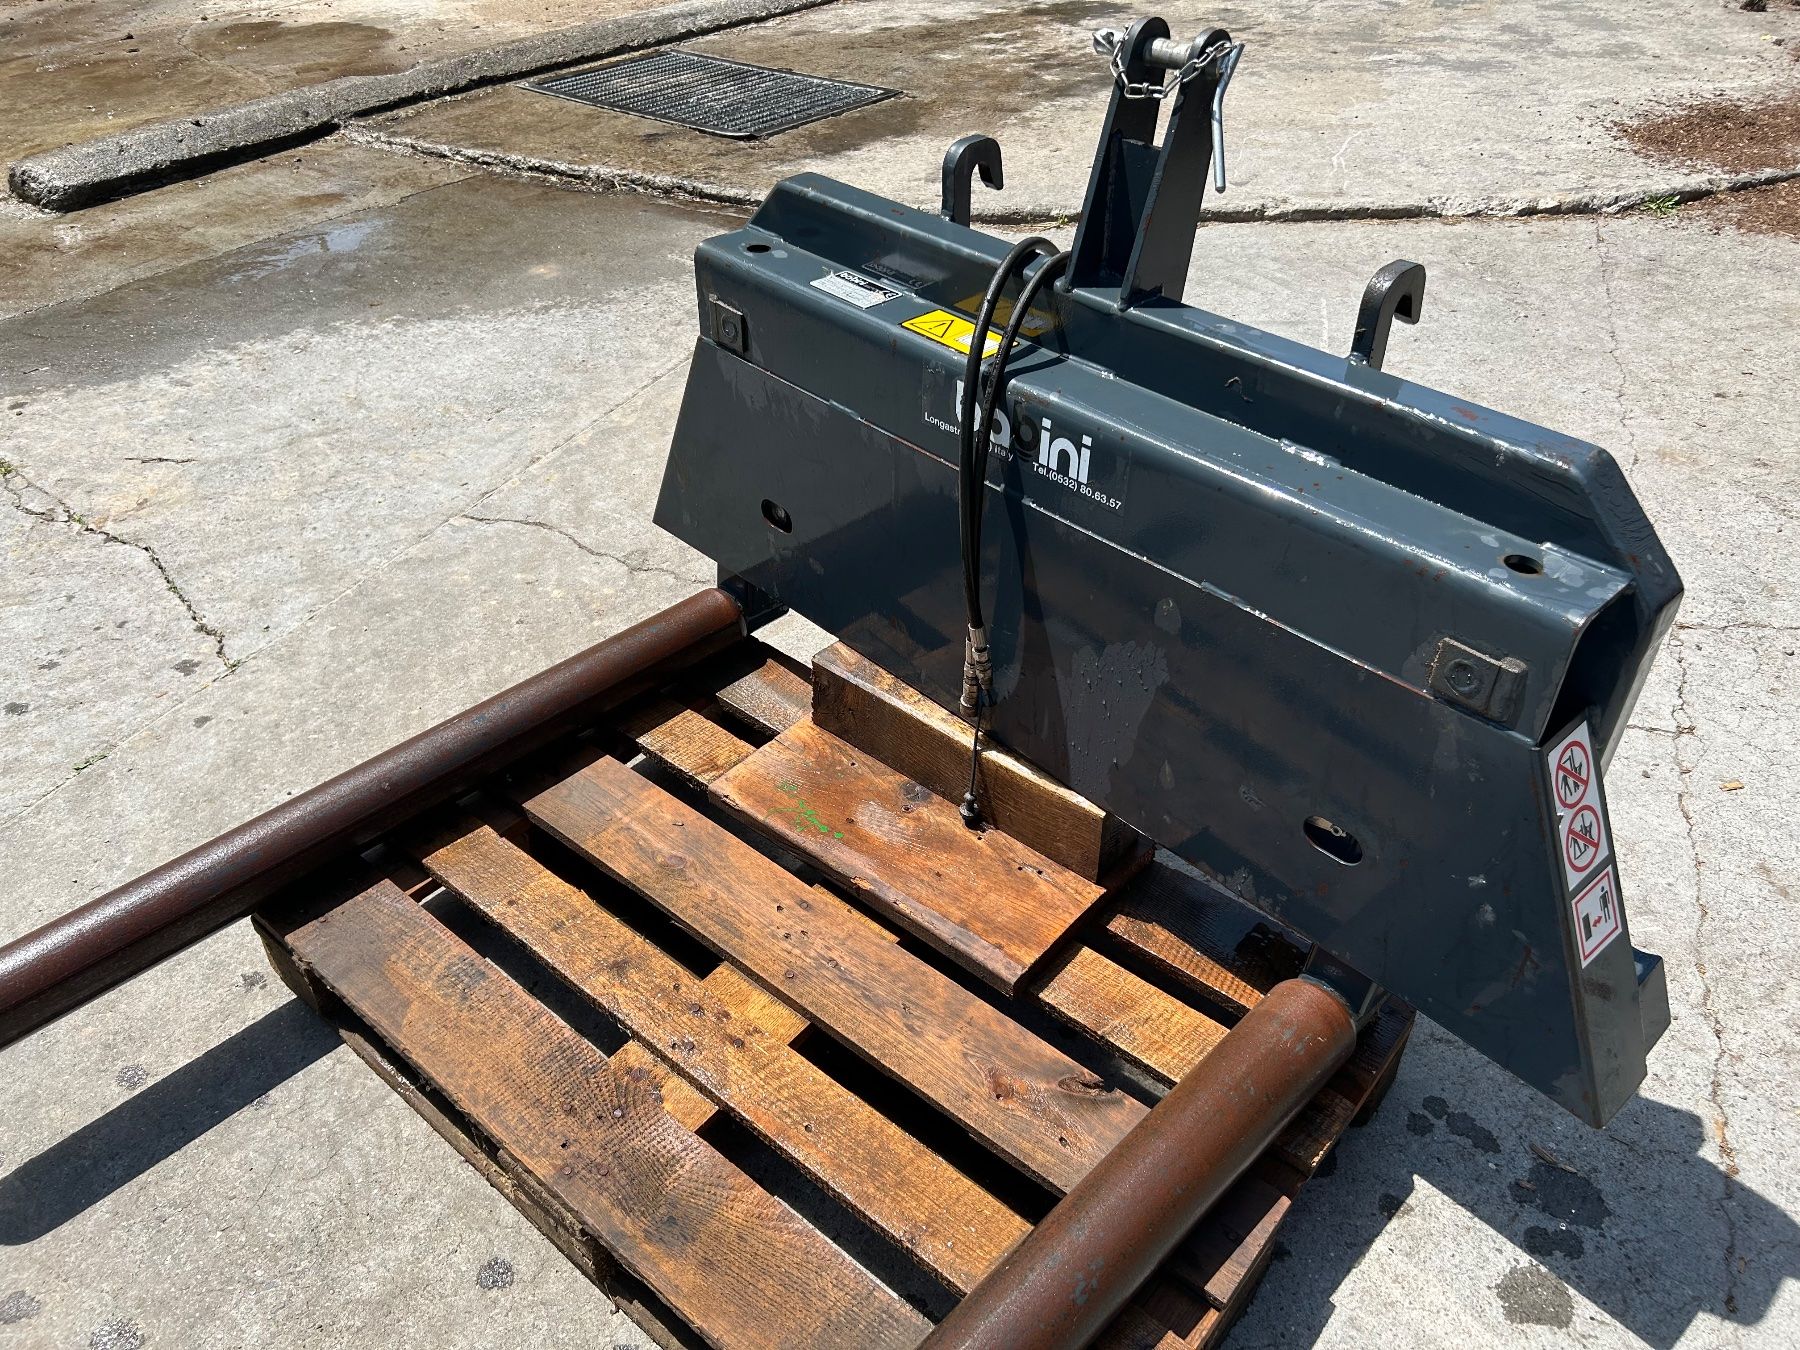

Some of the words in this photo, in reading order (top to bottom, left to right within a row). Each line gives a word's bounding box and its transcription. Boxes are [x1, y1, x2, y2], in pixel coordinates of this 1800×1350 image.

[924, 411, 961, 436] Longastr
[1032, 461, 1078, 492] Tel.(0532)
[1079, 484, 1122, 510] 80.63.57
